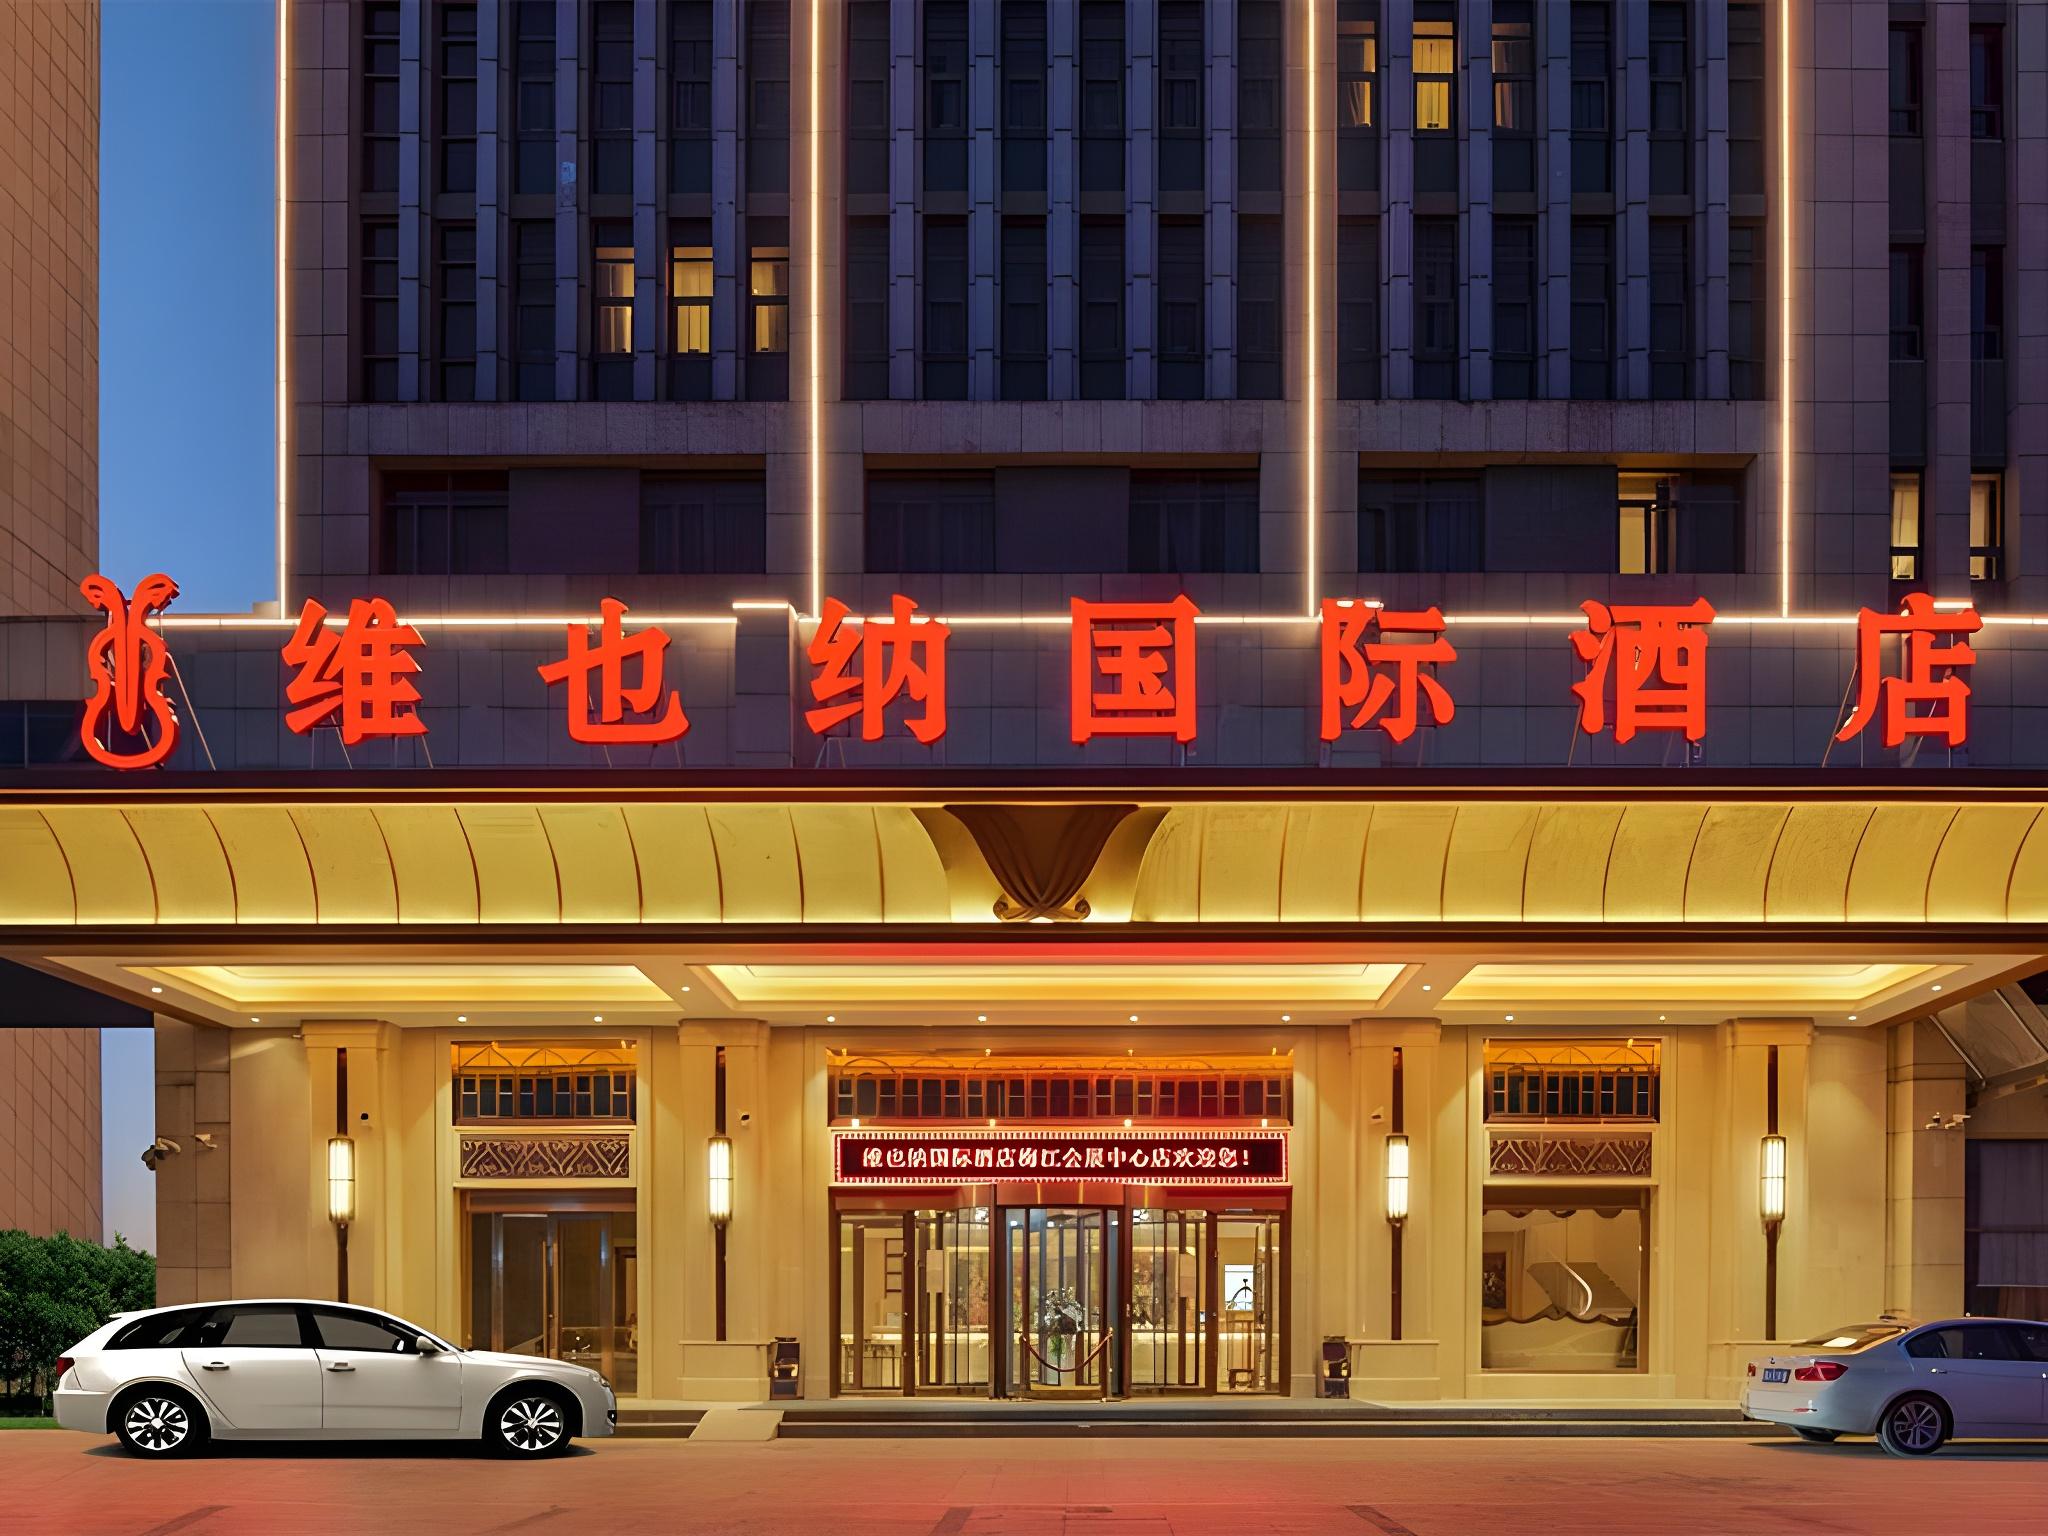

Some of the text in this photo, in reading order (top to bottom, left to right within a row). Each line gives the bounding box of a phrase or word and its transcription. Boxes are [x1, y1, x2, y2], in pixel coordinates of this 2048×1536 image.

[282, 593, 1983, 746] 维也纳国际酒店
